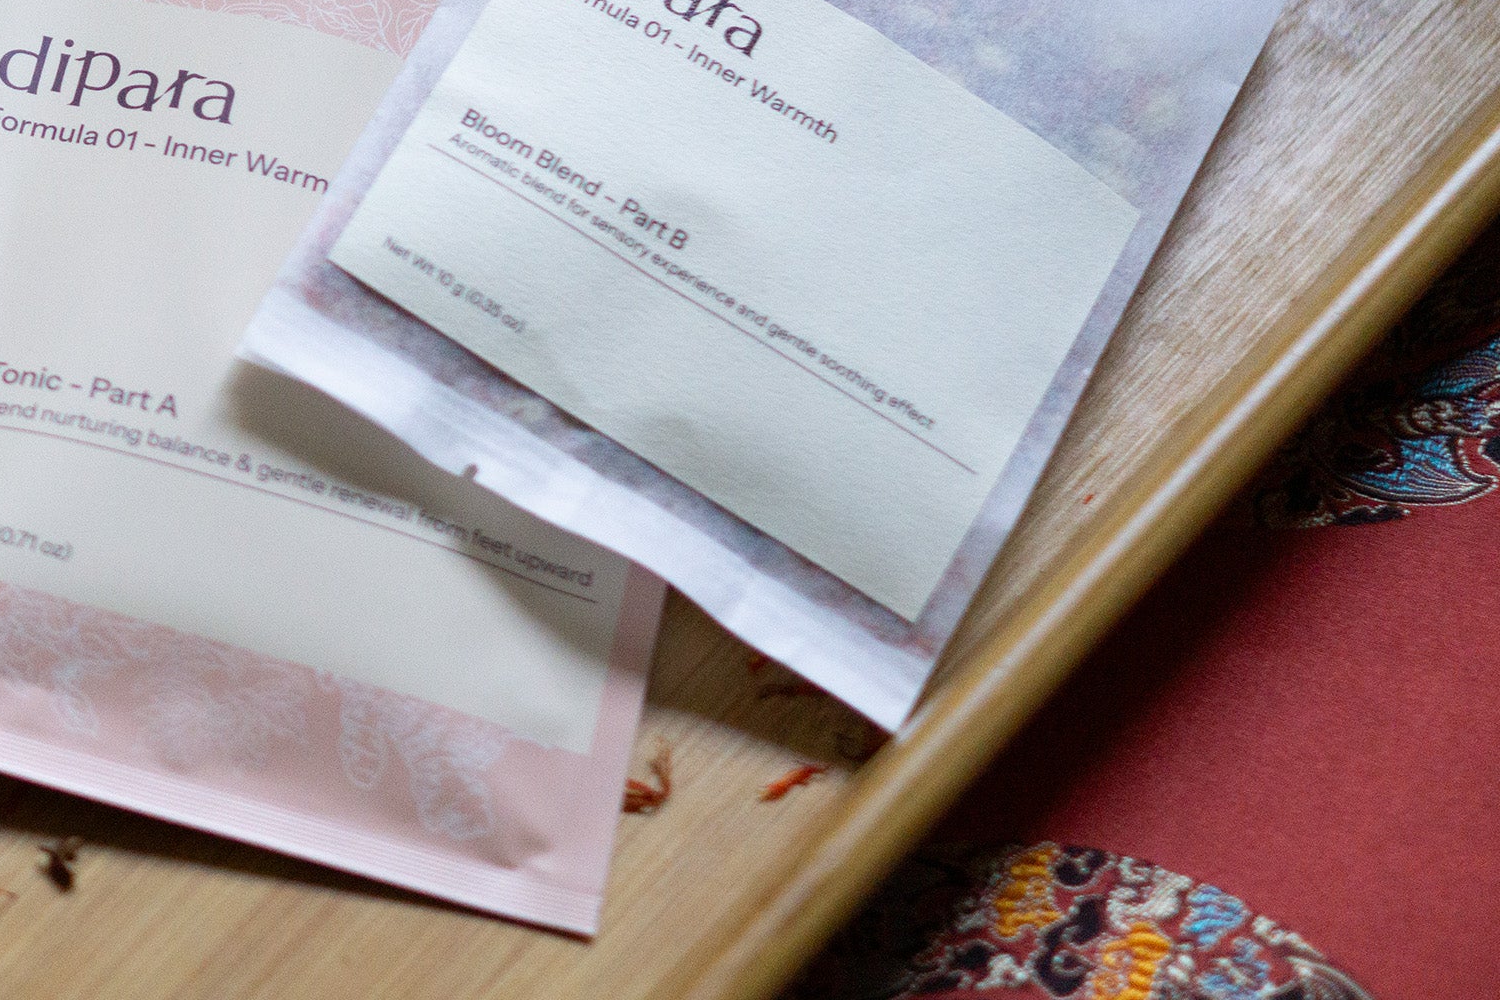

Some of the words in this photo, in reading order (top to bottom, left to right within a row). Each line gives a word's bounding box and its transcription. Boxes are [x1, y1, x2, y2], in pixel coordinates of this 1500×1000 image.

[106, 128, 139, 152] 01
[163, 135, 239, 167] Inner
[644, 20, 674, 46] 01
[687, 44, 748, 88] Inner
[750, 78, 839, 144] Warmth
[460, 107, 534, 159] Bloom
[535, 149, 603, 197] Blend
[618, 198, 670, 240] Part
[668, 228, 689, 250] B
[449, 132, 521, 179] Aromatic
[521, 172, 568, 206] blend
[568, 197, 591, 219] for
[590, 213, 649, 259] sensory
[651, 252, 736, 308] experience
[737, 303, 769, 327] and
[767, 322, 818, 358] gentle
[819, 353, 889, 404] soothing
[887, 395, 936, 431] effect
[89, 376, 150, 412] Part
[156, 393, 178, 418] A
[40, 408, 143, 446] nurturing
[147, 429, 231, 466] balance
[235, 453, 251, 473] &
[256, 462, 326, 494] gentle
[328, 485, 415, 522] renewal
[416, 506, 470, 542] from
[471, 527, 513, 559] feet
[515, 551, 594, 588] upward
